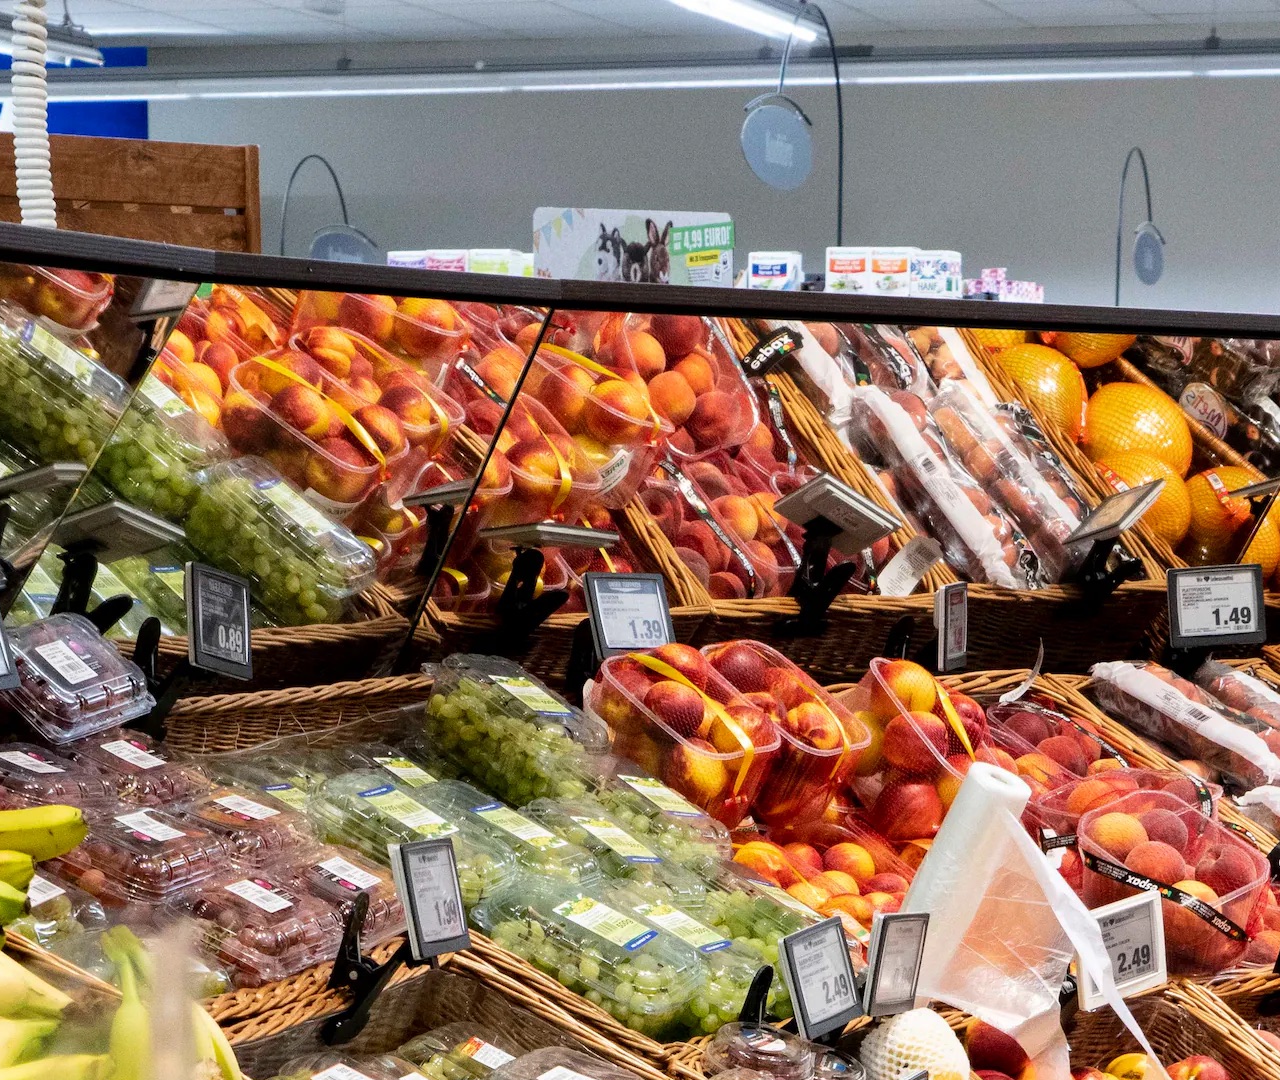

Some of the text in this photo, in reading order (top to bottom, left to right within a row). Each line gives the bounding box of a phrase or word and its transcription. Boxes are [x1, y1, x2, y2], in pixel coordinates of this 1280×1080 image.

[1212, 606, 1251, 626] 1.49
[218, 624, 243, 653] 0.89
[629, 619, 663, 640] 1.39
[1126, 874, 1159, 893] espax
[1117, 944, 1151, 973] 2.49
[822, 973, 849, 1005] 2.49
